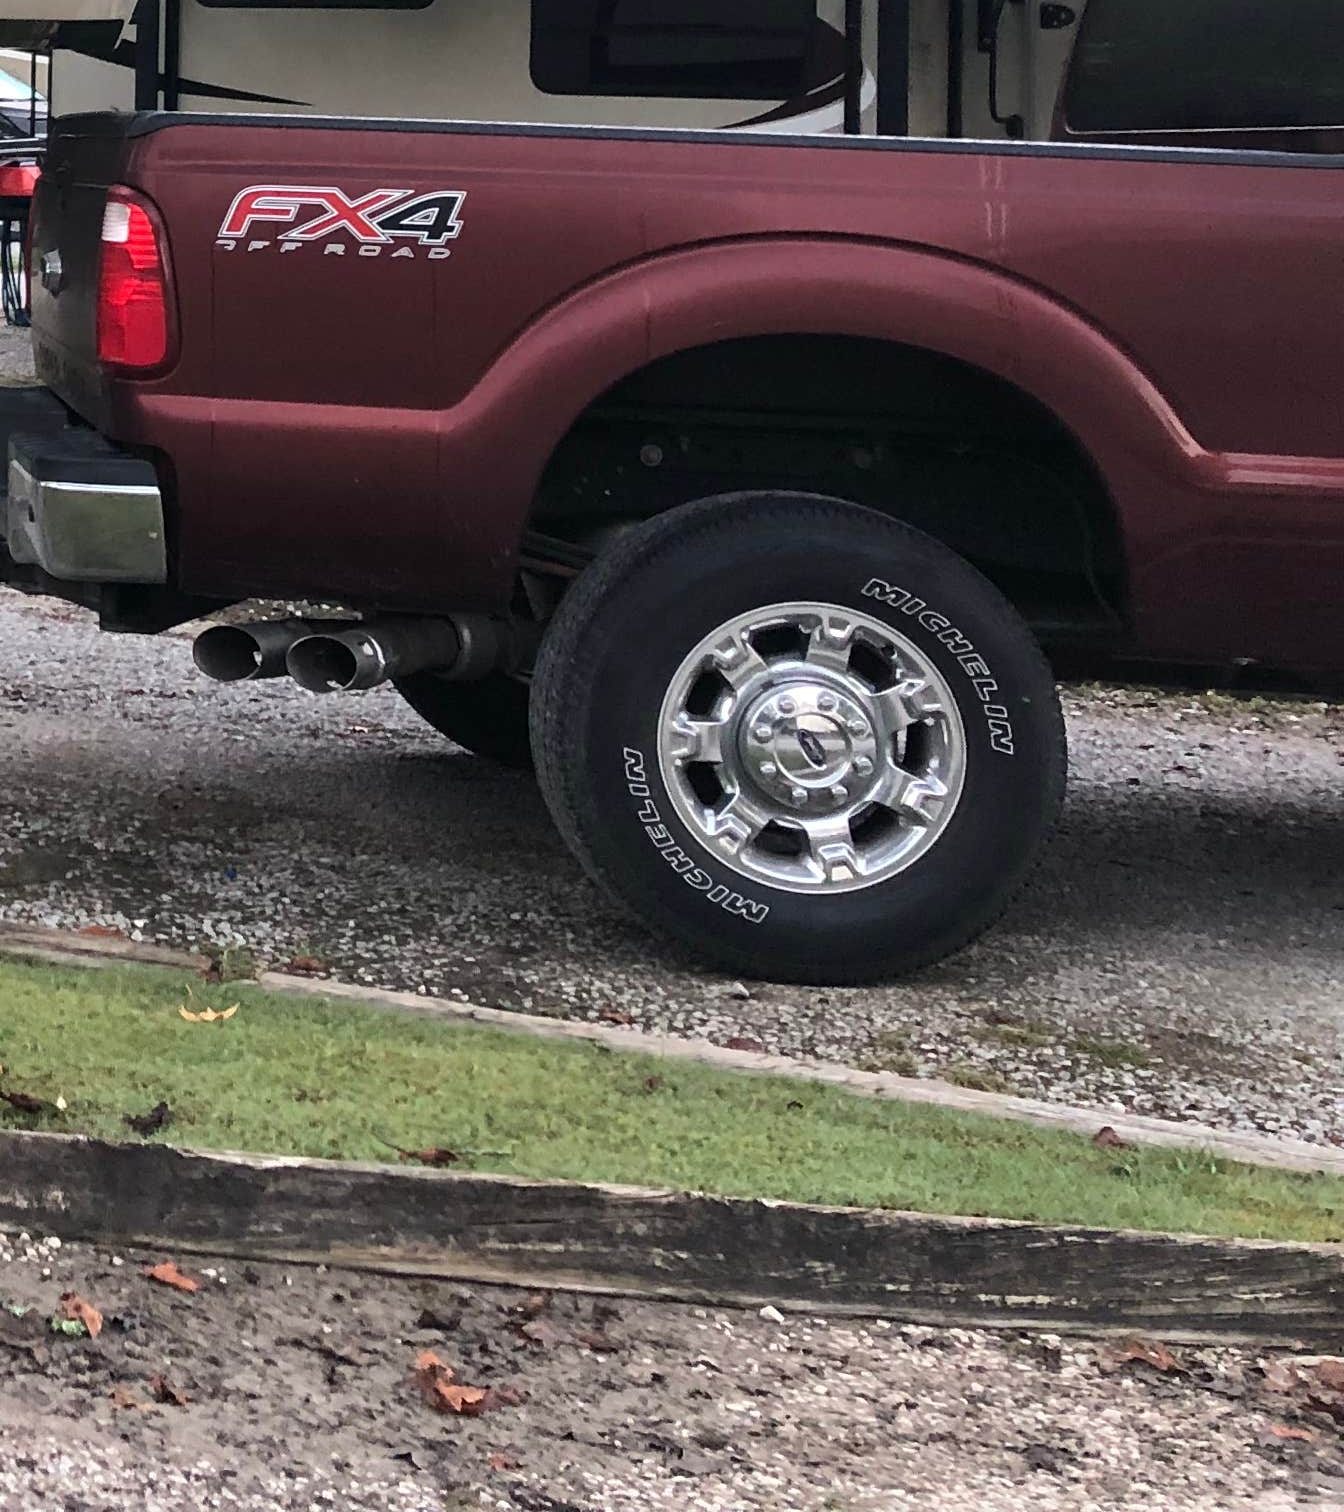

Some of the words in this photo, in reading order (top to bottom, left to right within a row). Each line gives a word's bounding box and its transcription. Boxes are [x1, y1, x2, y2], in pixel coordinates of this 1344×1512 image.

[217, 184, 468, 246] FX4
[323, 242, 452, 259] ROAD
[861, 577, 1014, 755] MICHELIN
[623, 746, 770, 924] MICHELIN
